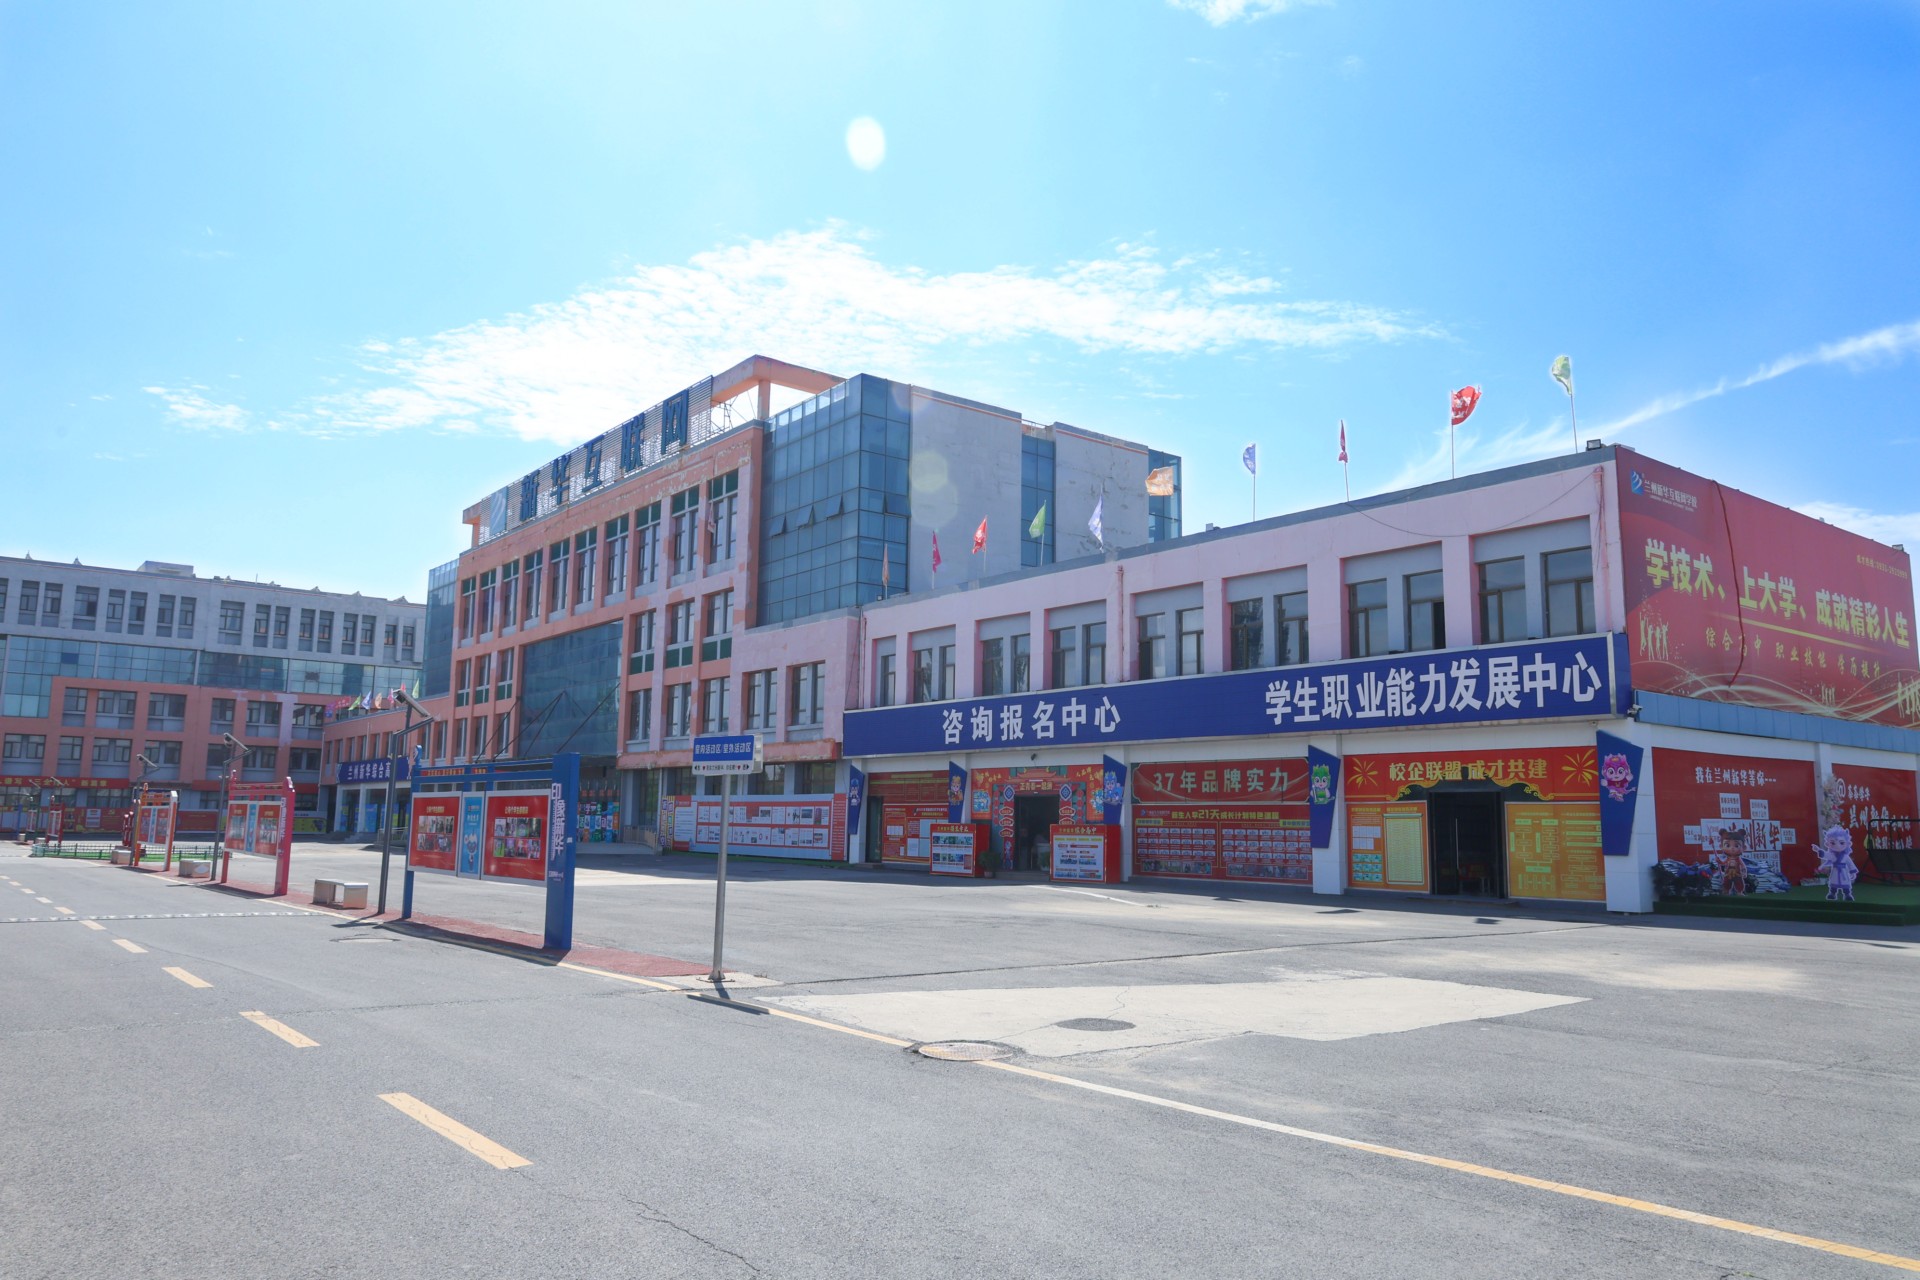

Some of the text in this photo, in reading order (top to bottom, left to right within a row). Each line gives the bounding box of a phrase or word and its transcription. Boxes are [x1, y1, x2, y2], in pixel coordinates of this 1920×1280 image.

[519, 389, 689, 522] 新华互联网
[1775, 642, 1827, 668] 职业技能
[1265, 651, 1602, 726] 学生职业能力发展中心
[942, 696, 1121, 744] 咨询报名中心
[347, 761, 391, 780] 兰州新华综合高
[1153, 767, 1289, 793] 37年品牌实力
[1389, 758, 1548, 781] 校企联盟 成才共建
